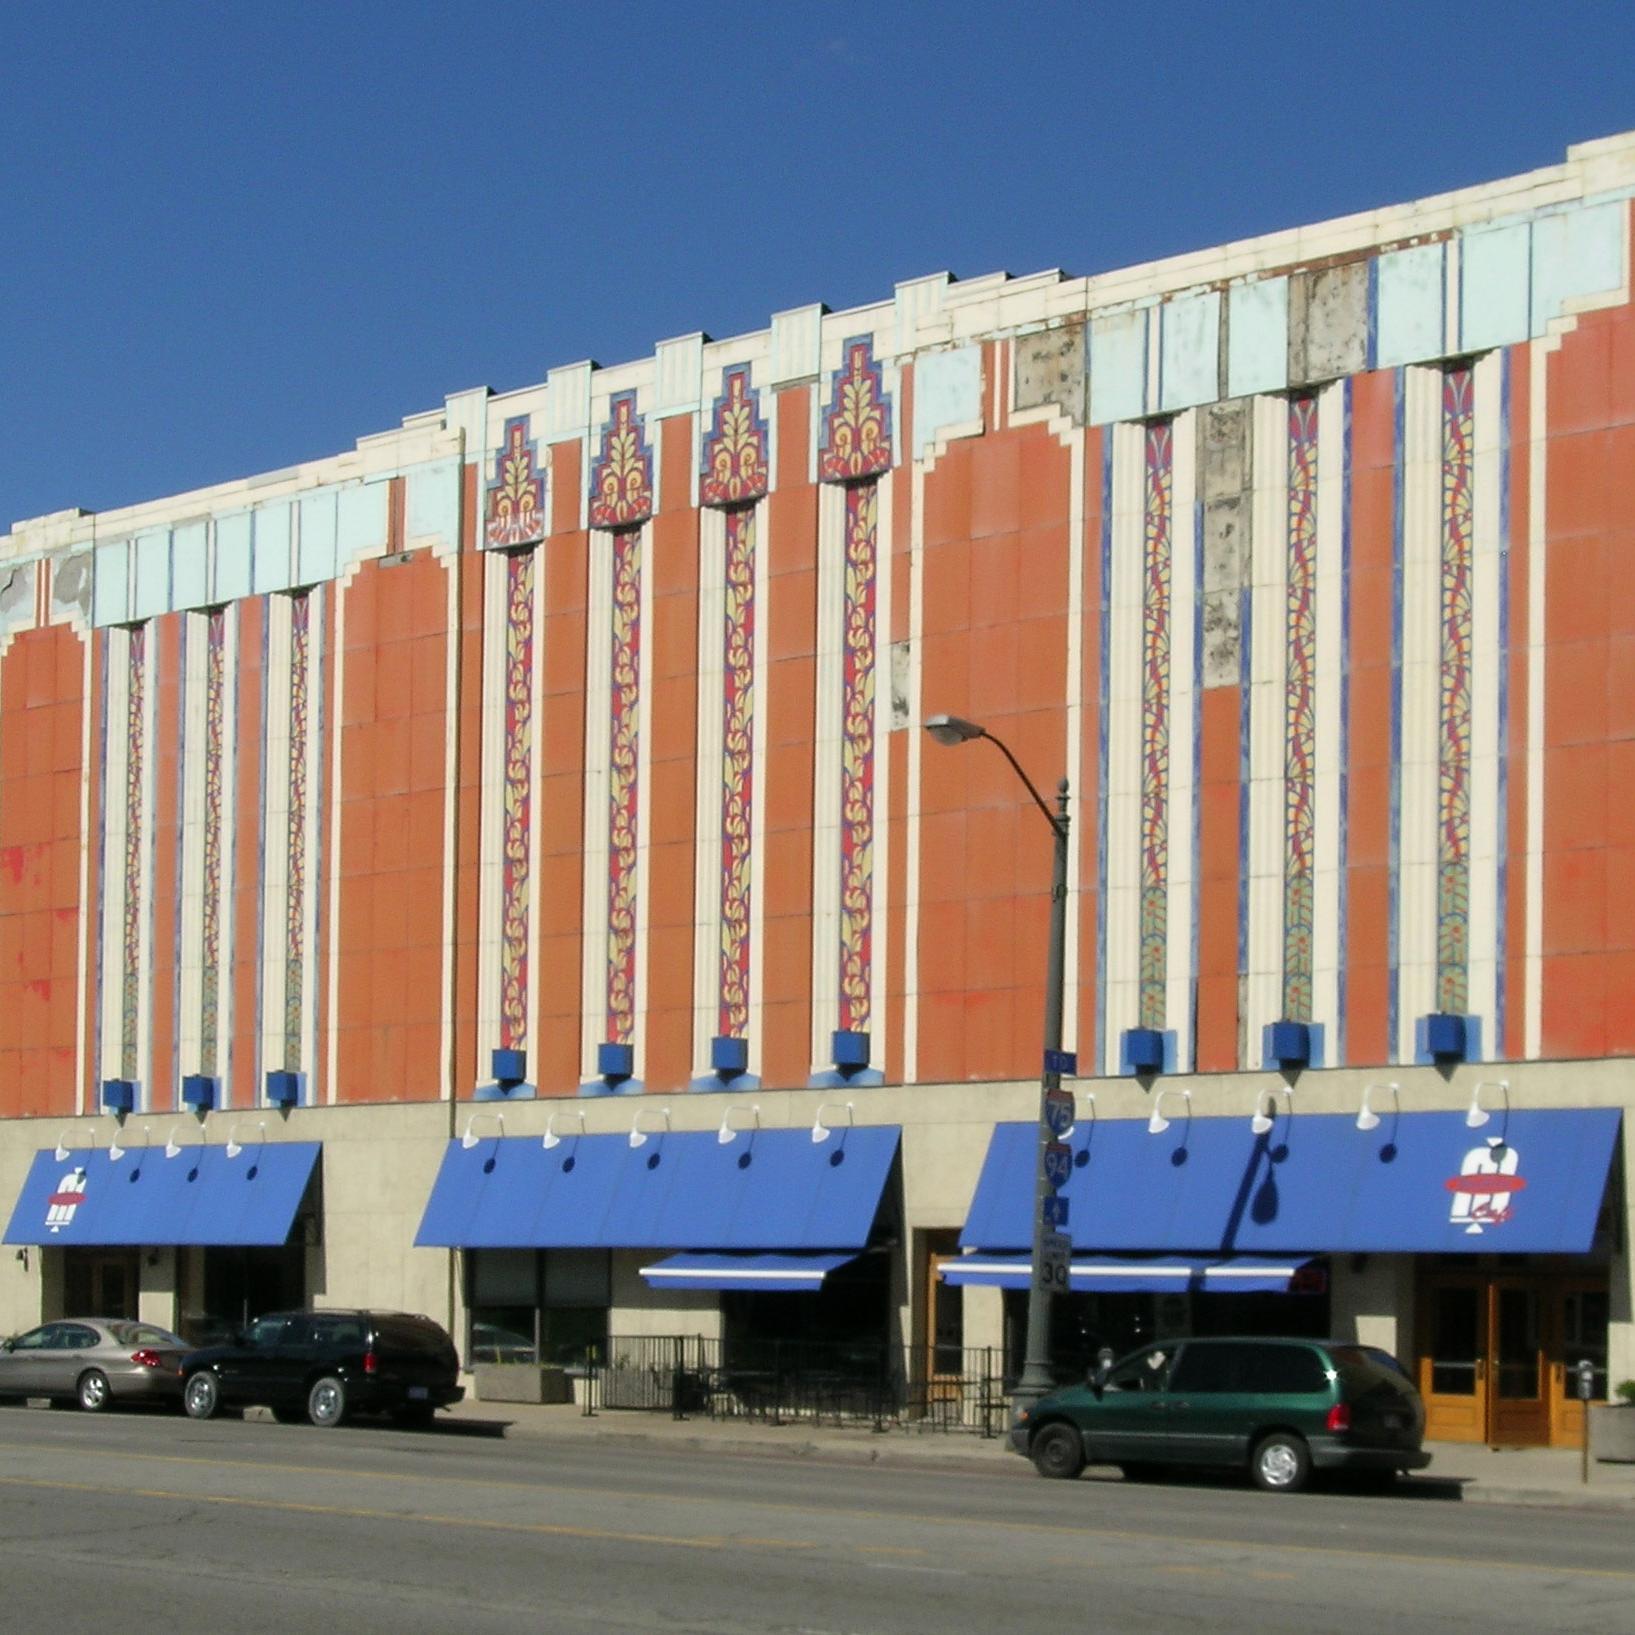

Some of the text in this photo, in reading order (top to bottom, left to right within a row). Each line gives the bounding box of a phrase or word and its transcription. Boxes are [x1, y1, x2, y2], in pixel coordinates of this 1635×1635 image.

[1047, 1101, 1072, 1128] 75
[1046, 1153, 1068, 1177] 94
[1042, 1262, 1068, 1285] 30
